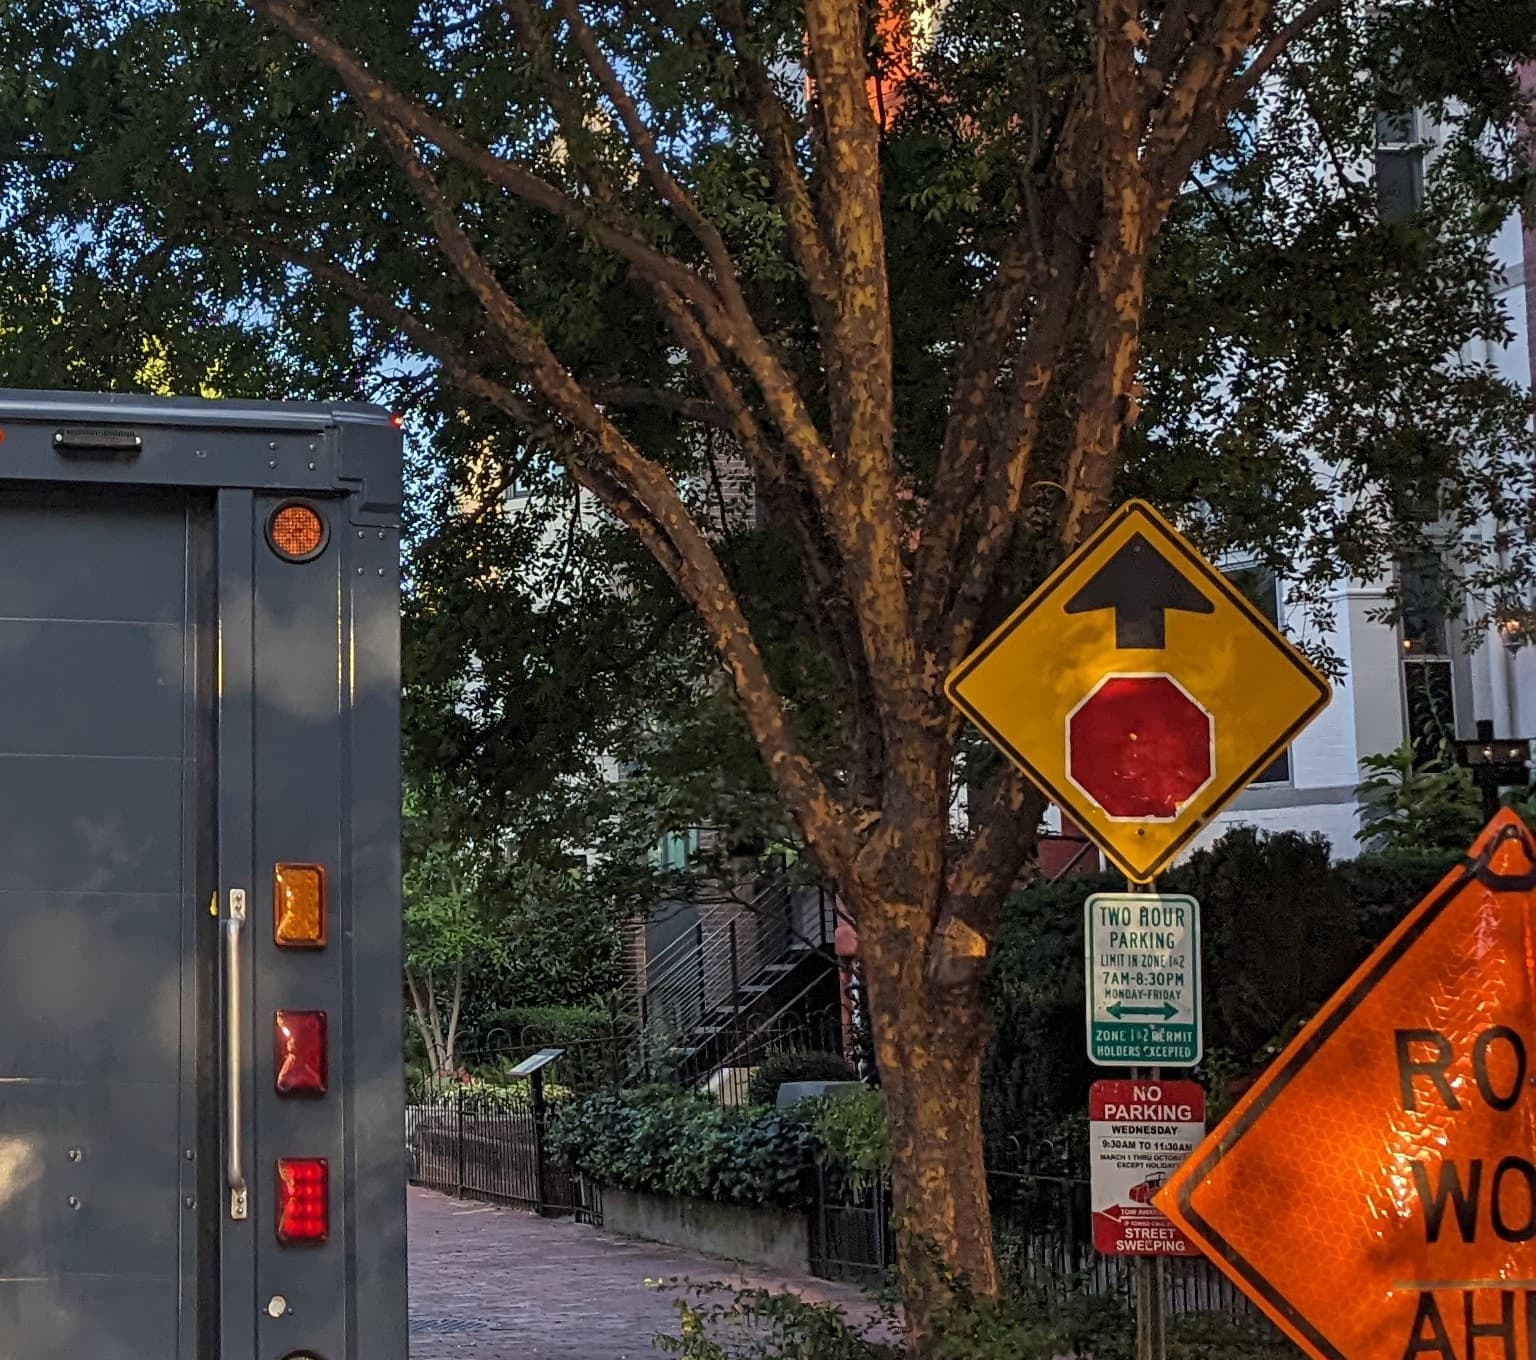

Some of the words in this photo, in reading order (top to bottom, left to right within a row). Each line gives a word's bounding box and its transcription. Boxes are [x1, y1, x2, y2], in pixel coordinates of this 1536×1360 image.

[1100, 906, 1131, 927] TWO
[1139, 906, 1185, 928] HOUR
[1109, 931, 1175, 950] PARKING
[1100, 953, 1125, 968] LIMIT
[1128, 954, 1138, 968] IN
[1141, 954, 1166, 969] ZONE
[1102, 971, 1184, 986] 7AM-8:30PM
[1104, 988, 1182, 1001] MONDAY-FRIDAY
[1095, 1029, 1127, 1042] ZONE
[1096, 1045, 1142, 1058] HOLDERS
[1393, 1025, 1527, 1112] RO
[1132, 1084, 1162, 1102] NO
[1103, 1103, 1192, 1121] PARKING
[1111, 1125, 1178, 1135] WEDNESDAY
[1102, 1139, 1136, 1149] 9:30AM
[1139, 1141, 1151, 1150] TO
[1154, 1142, 1193, 1152] 11:30AM
[1412, 1155, 1536, 1243] WO
[1124, 1227, 1176, 1239] STREET
